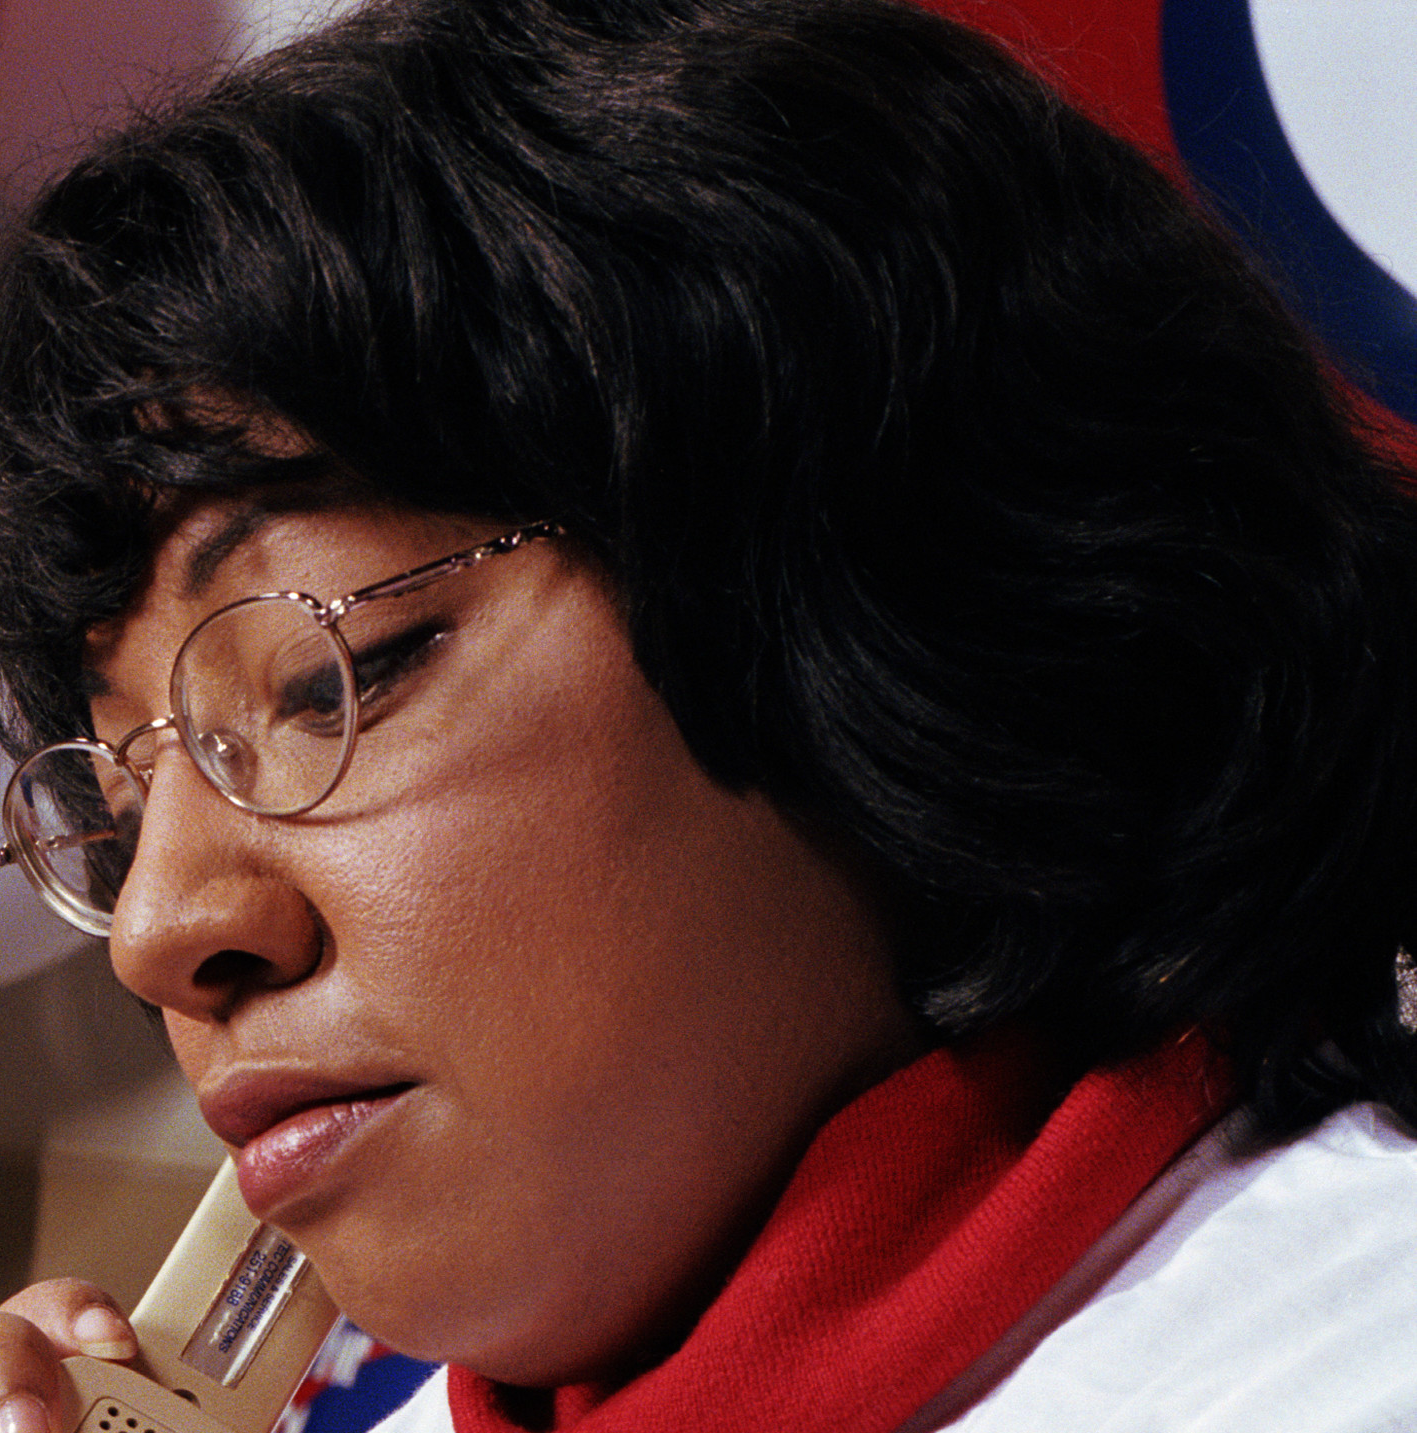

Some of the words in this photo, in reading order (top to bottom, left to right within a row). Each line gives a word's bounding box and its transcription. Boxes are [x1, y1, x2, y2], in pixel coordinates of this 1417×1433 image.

[227, 1250, 267, 1306] 251-9188
[276, 1255, 297, 1284] SALES
[218, 1261, 278, 1353] COMMUNICATIONS
[248, 1293, 275, 1329] SERVICE
